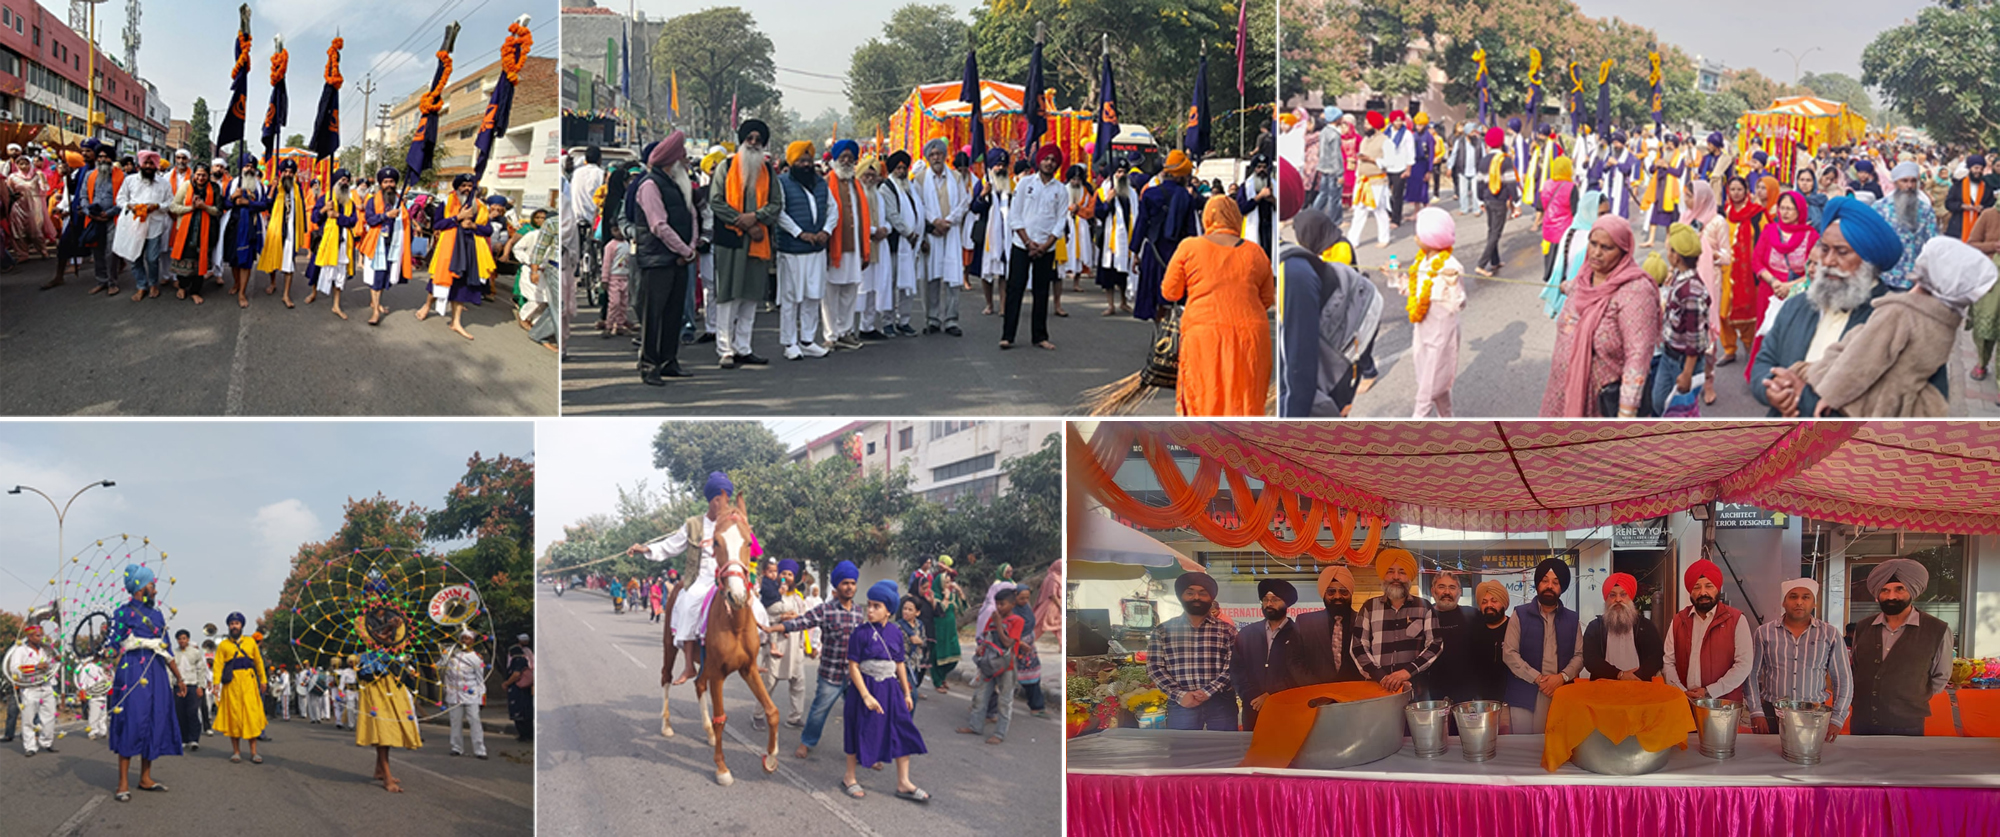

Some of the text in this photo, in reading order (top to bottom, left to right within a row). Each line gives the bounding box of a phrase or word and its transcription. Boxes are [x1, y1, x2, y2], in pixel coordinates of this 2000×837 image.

[1720, 511, 1757, 519] ARCHITECT
[1615, 527, 1647, 536] RENEW
[431, 588, 470, 617] KRISHNA
